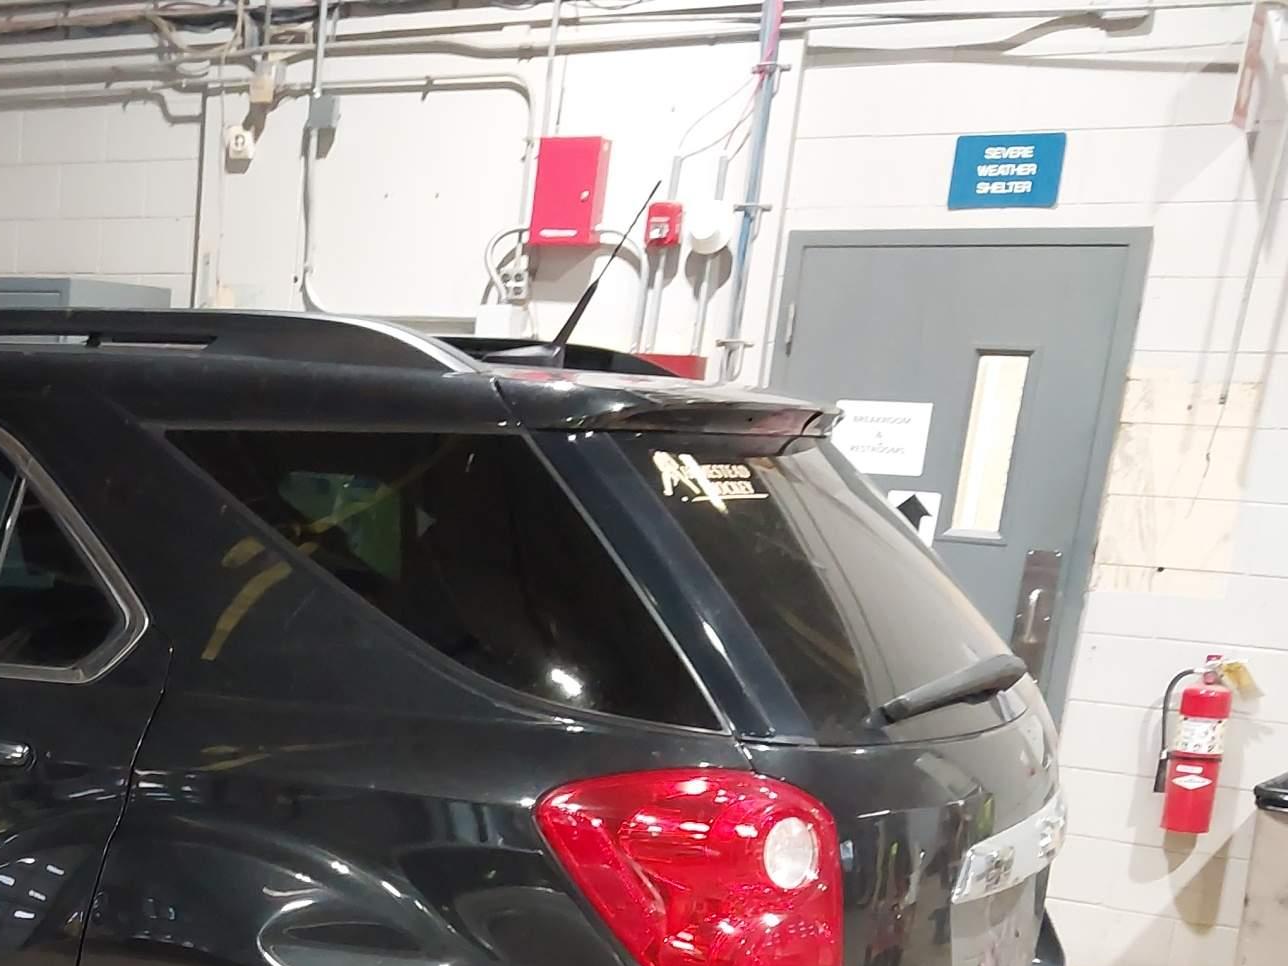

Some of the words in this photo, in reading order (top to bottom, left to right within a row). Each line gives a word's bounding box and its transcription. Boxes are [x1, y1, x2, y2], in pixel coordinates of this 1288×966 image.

[984, 146, 1035, 160] SEVERE
[977, 163, 1037, 176] WEATHER
[976, 181, 1032, 194] SHELTER
